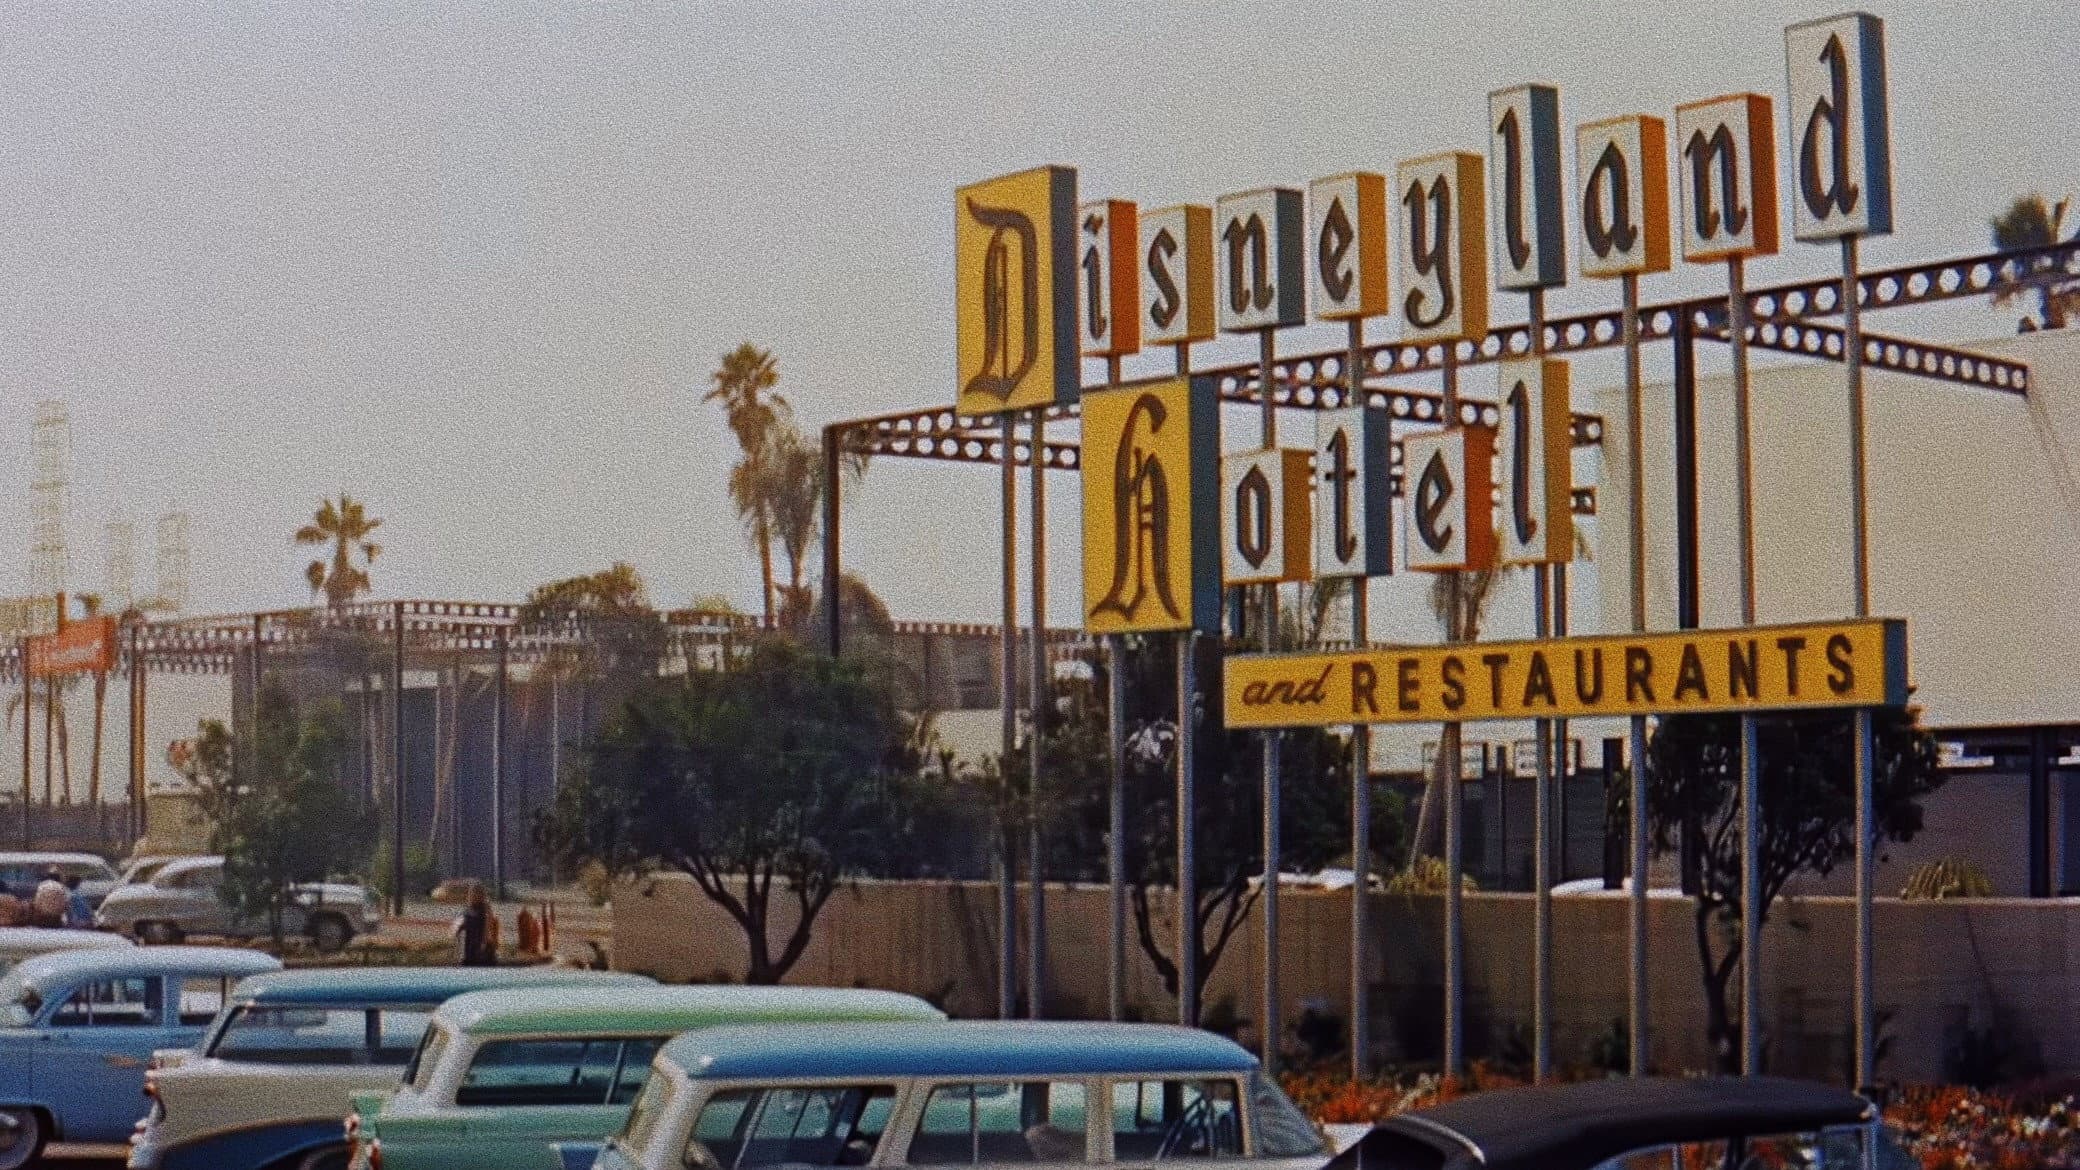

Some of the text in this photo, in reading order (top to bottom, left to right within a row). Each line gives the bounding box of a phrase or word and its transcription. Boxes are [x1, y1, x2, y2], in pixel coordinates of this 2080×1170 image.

[964, 32, 1862, 403] Disneyland
[1242, 634, 1856, 713] and RESTAURANTS
